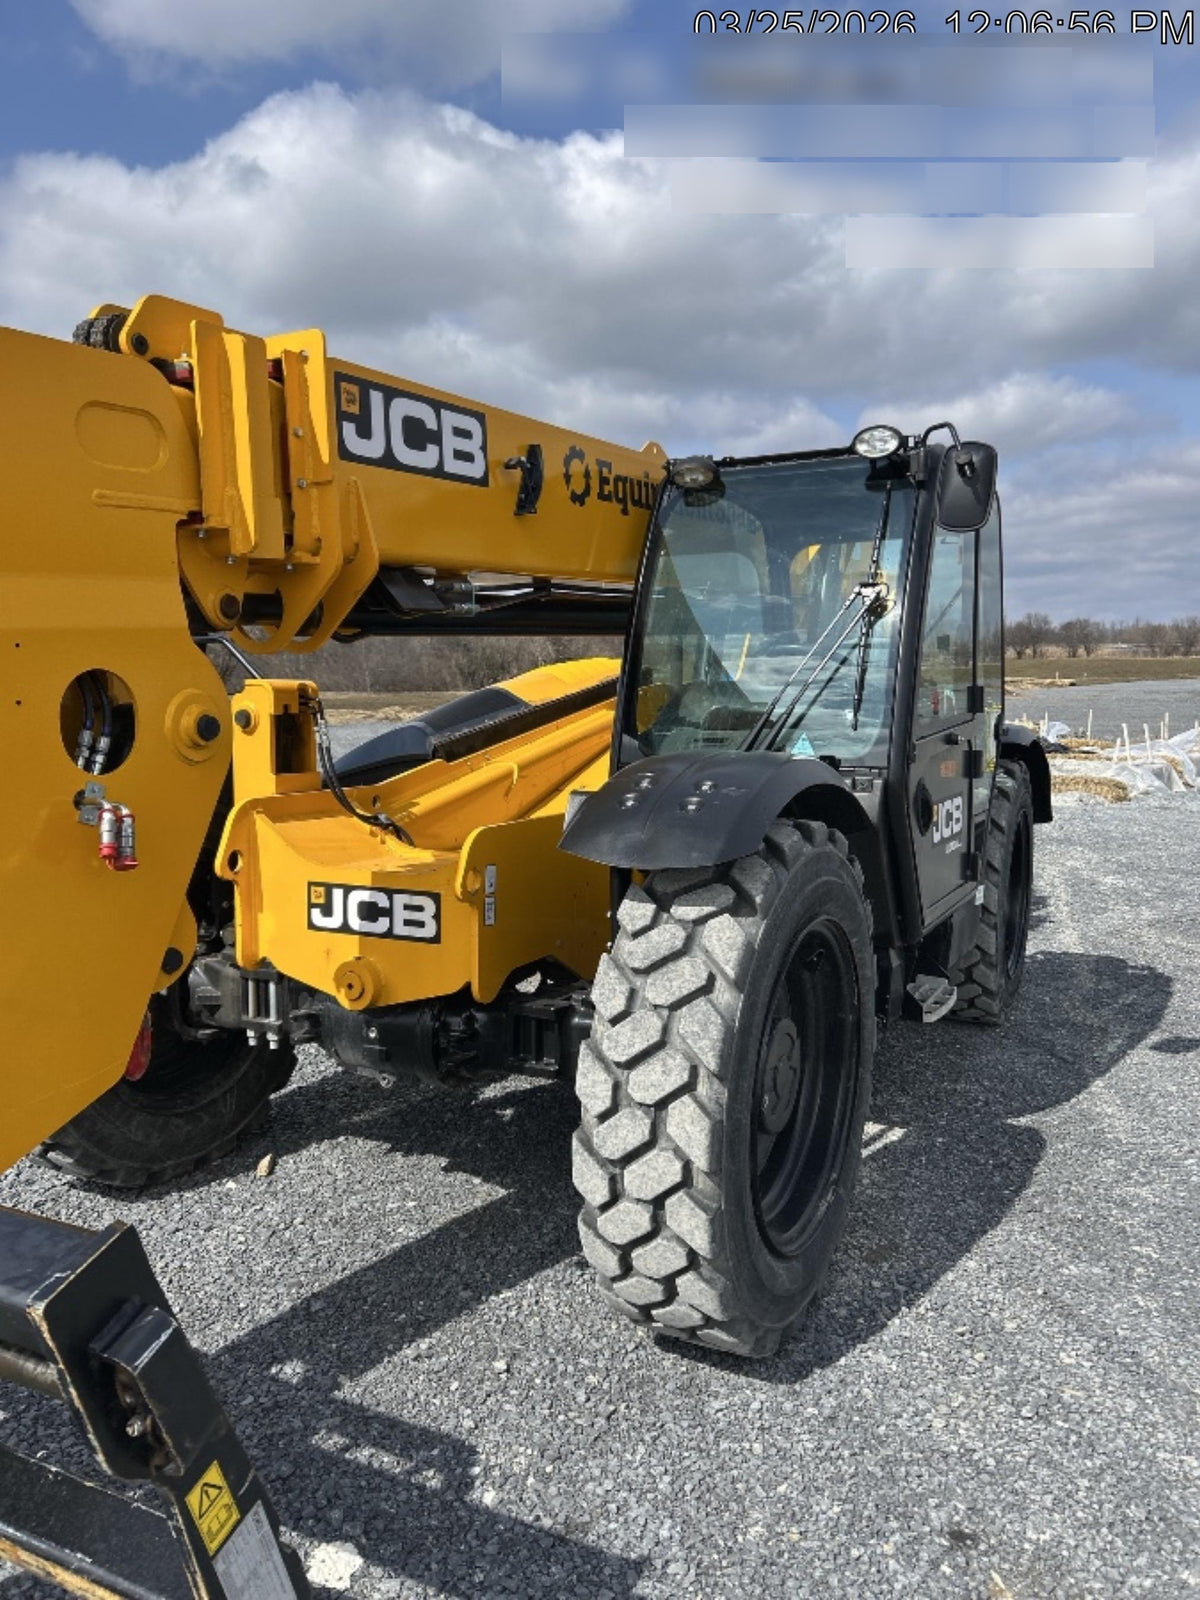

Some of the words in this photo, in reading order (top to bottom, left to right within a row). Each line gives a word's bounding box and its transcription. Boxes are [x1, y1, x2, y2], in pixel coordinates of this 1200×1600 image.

[341, 387, 487, 480] JCB
[932, 795, 963, 844] JCB
[310, 887, 438, 938] JCB
